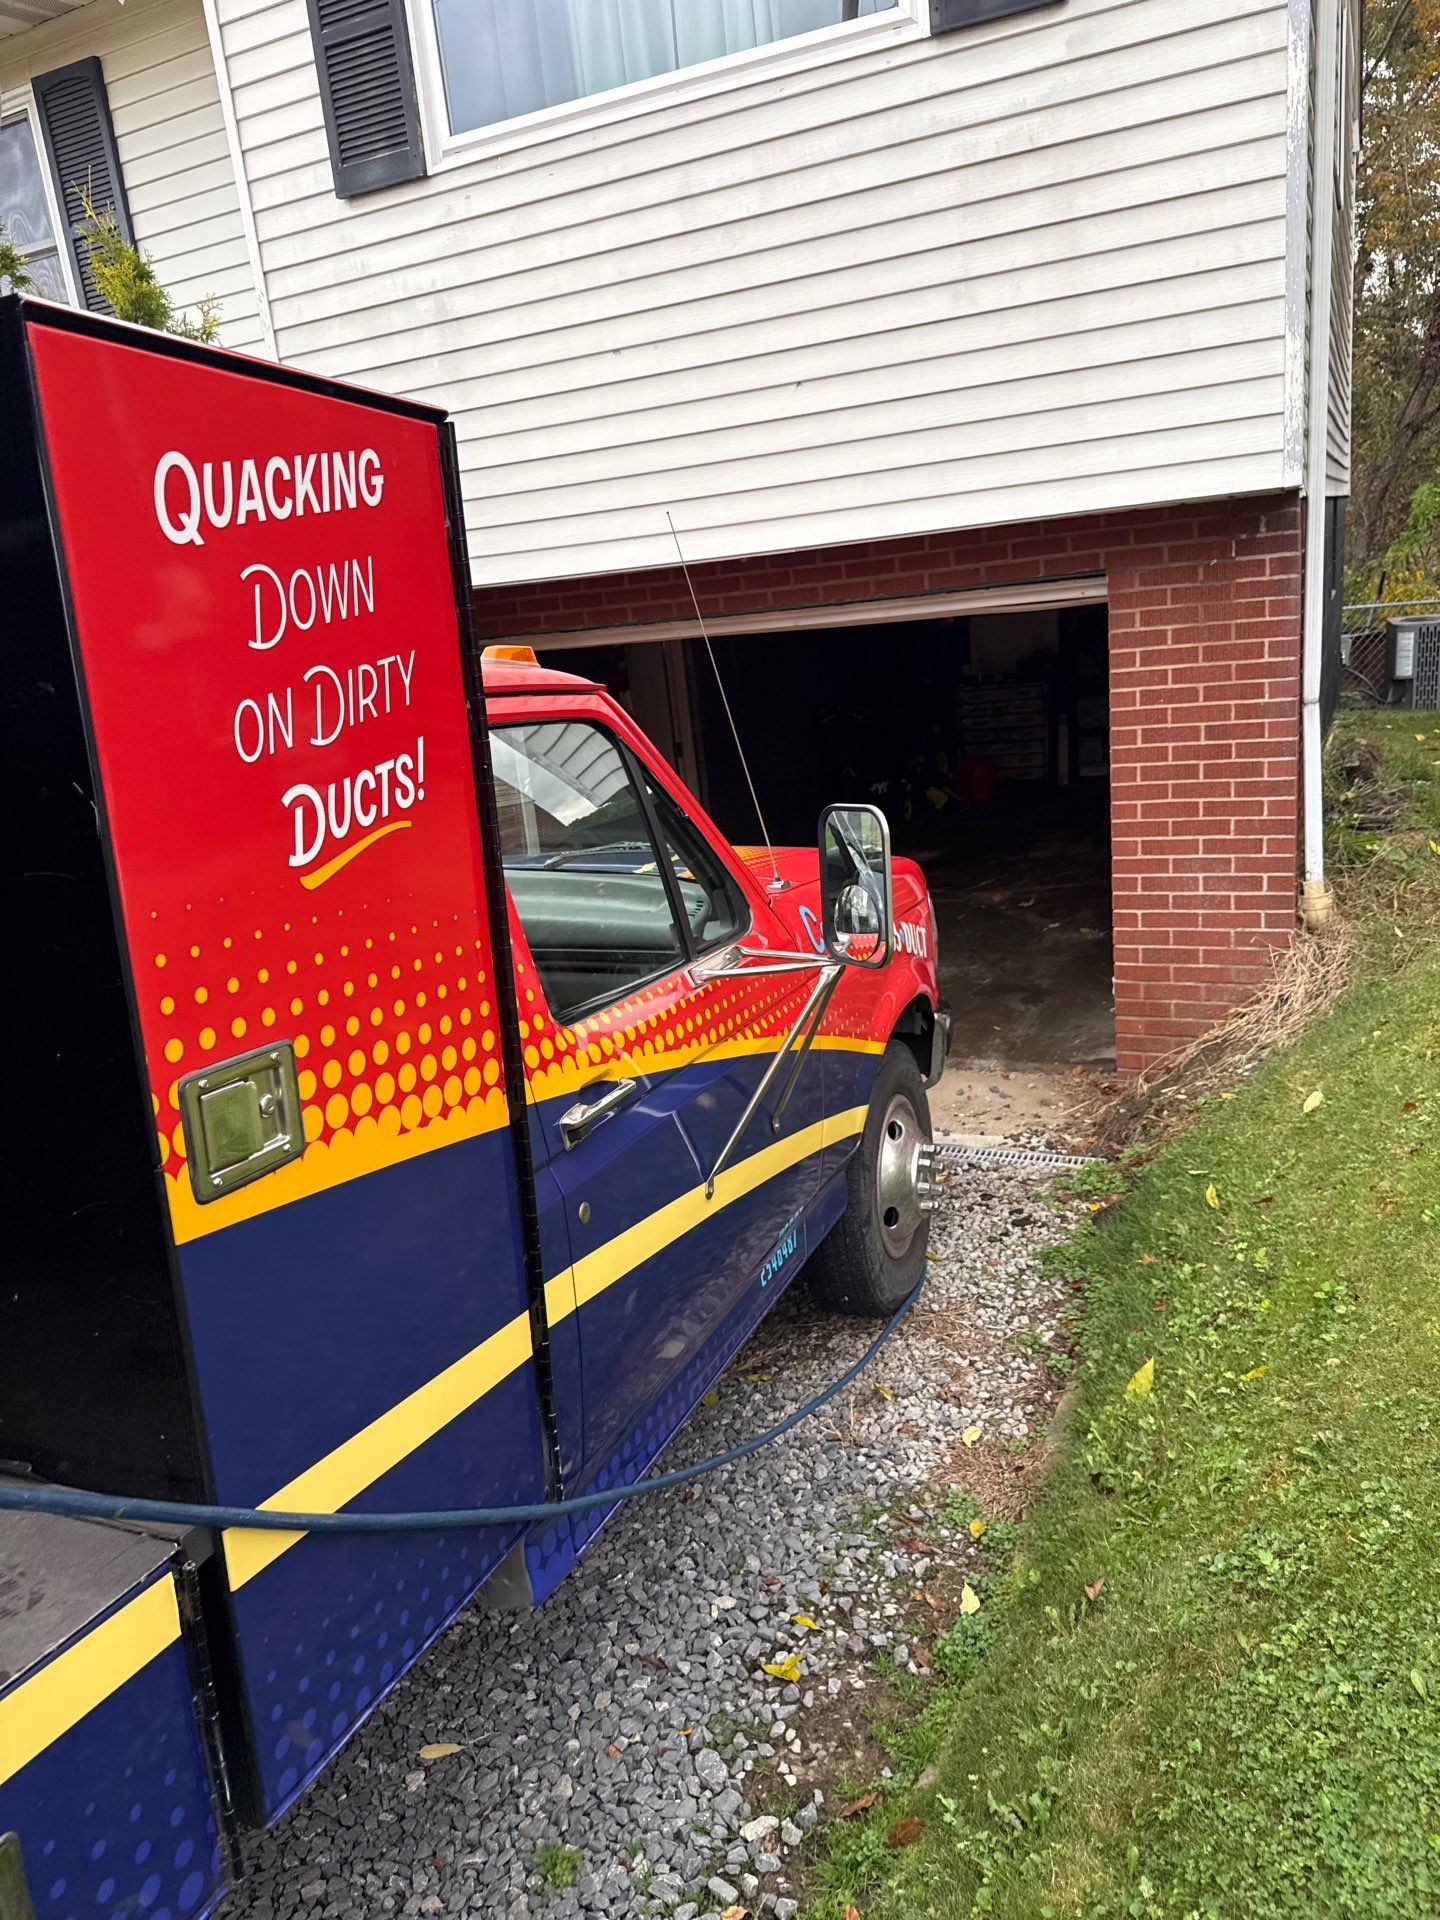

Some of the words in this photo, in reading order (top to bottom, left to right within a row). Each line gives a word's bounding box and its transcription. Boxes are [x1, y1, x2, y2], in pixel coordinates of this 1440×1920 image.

[153, 448, 385, 546] QUACKING
[240, 555, 375, 650] DOWN
[234, 686, 294, 763] ON
[303, 650, 416, 747] DIRTY
[281, 736, 426, 867] DUCTS!
